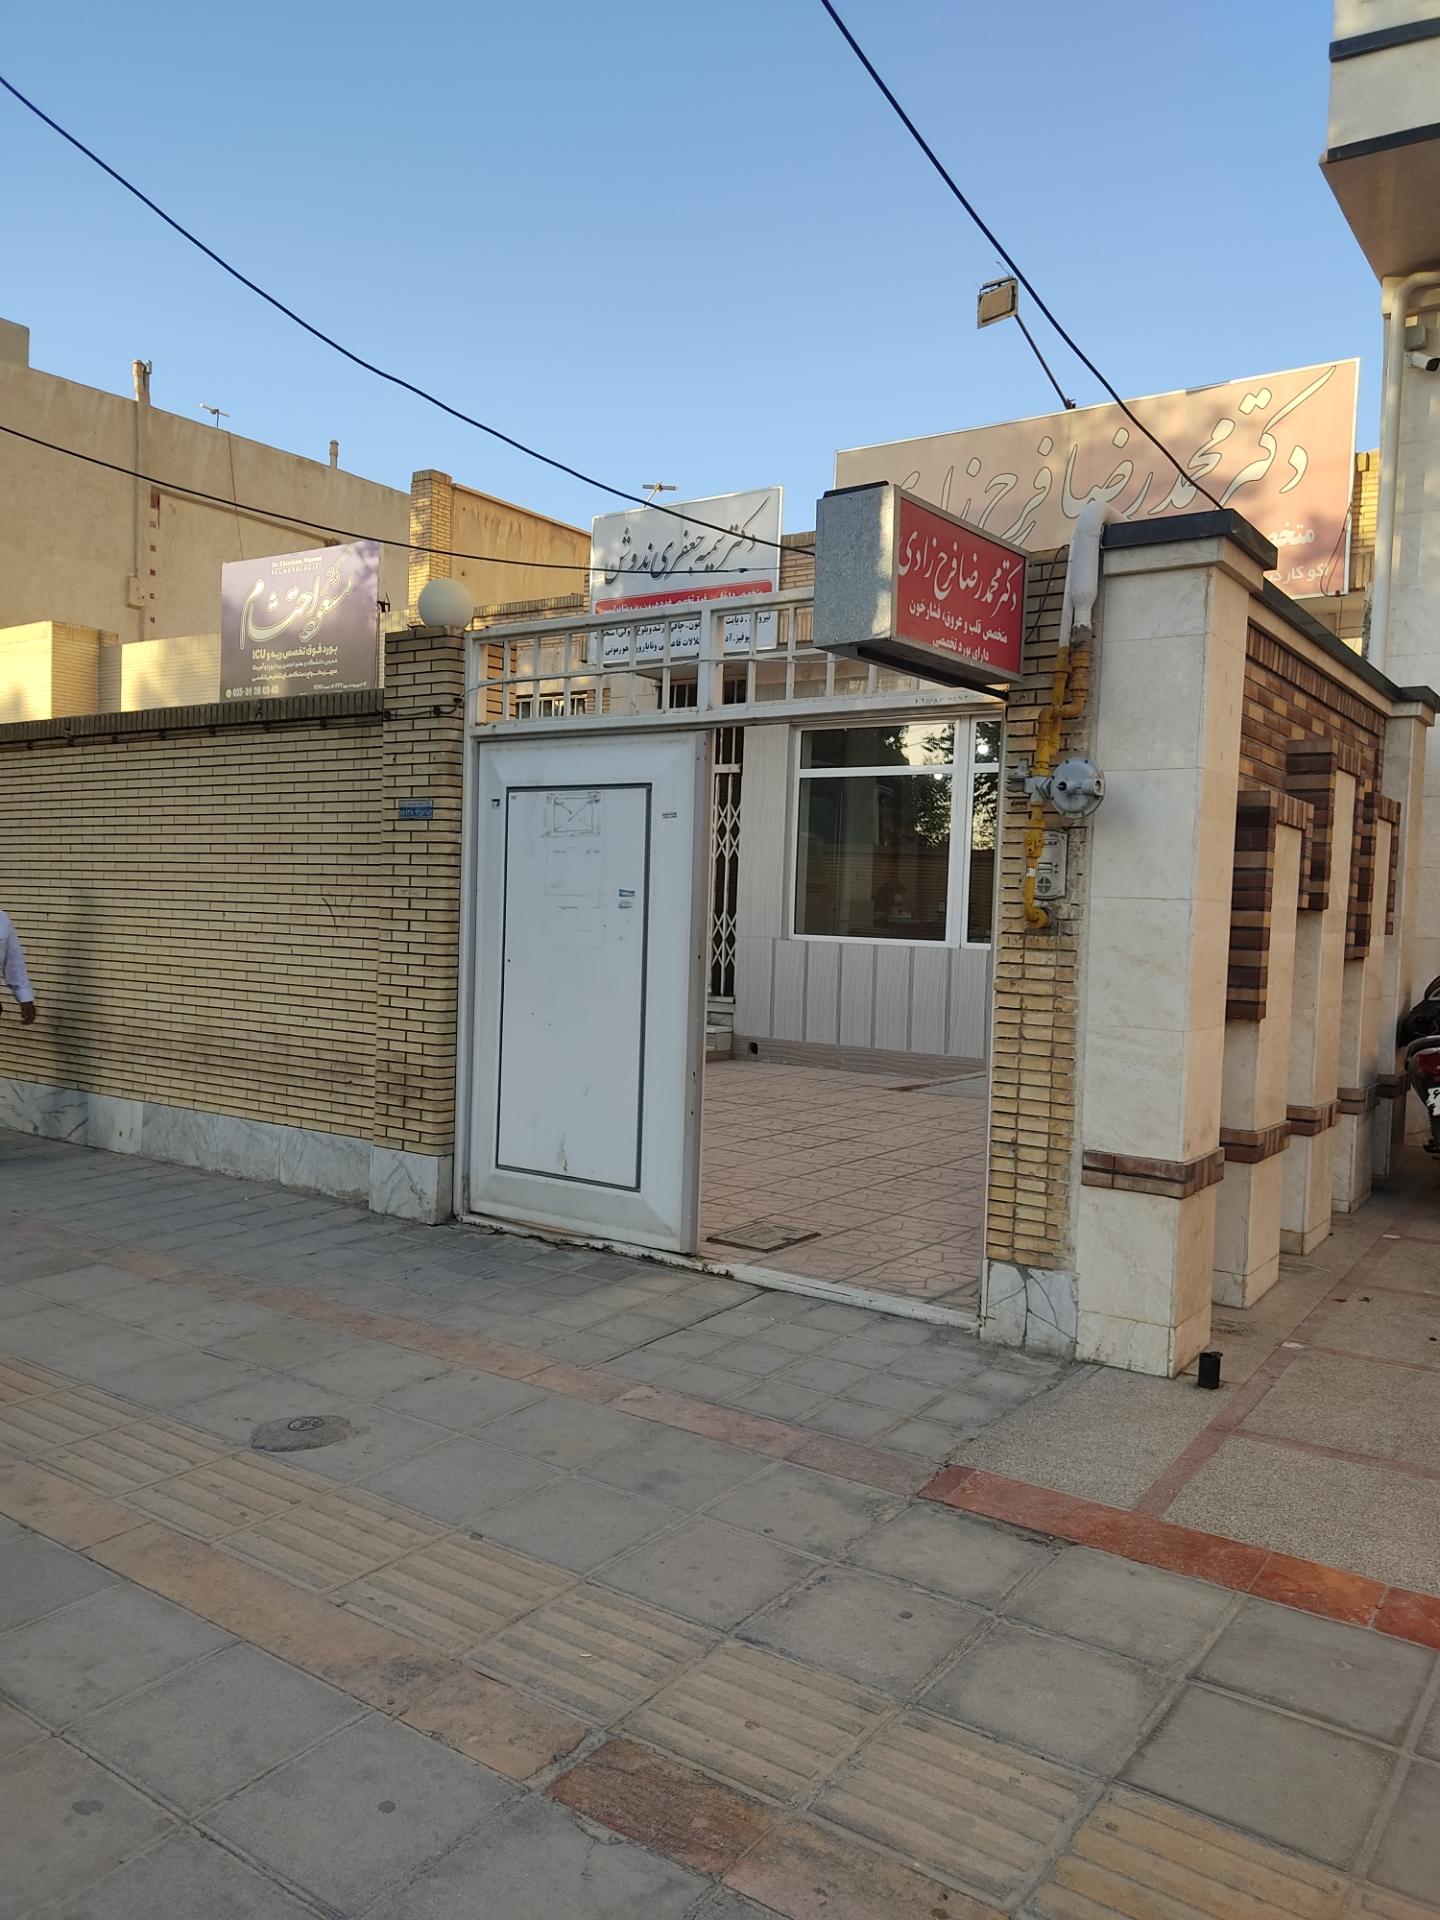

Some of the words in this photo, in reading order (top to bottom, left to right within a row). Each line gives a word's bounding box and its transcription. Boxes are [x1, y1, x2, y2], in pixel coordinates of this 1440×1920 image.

[1213, 365, 1337, 510] دکتر
[716, 495, 770, 570] دکتر
[651, 529, 707, 580] جعفری
[990, 560, 1024, 618] دکتر
[964, 620, 968, 634] و
[969, 619, 982, 637] قلب
[983, 623, 1008, 644] متخصص
[306, 642, 322, 657] فوق
[322, 645, 338, 656] بورد
[932, 635, 957, 651] تخصصی
[957, 641, 972, 658] بورد
[252, 648, 266, 660] ICU
[283, 646, 306, 659] تخصص
[972, 645, 990, 663] دارای
